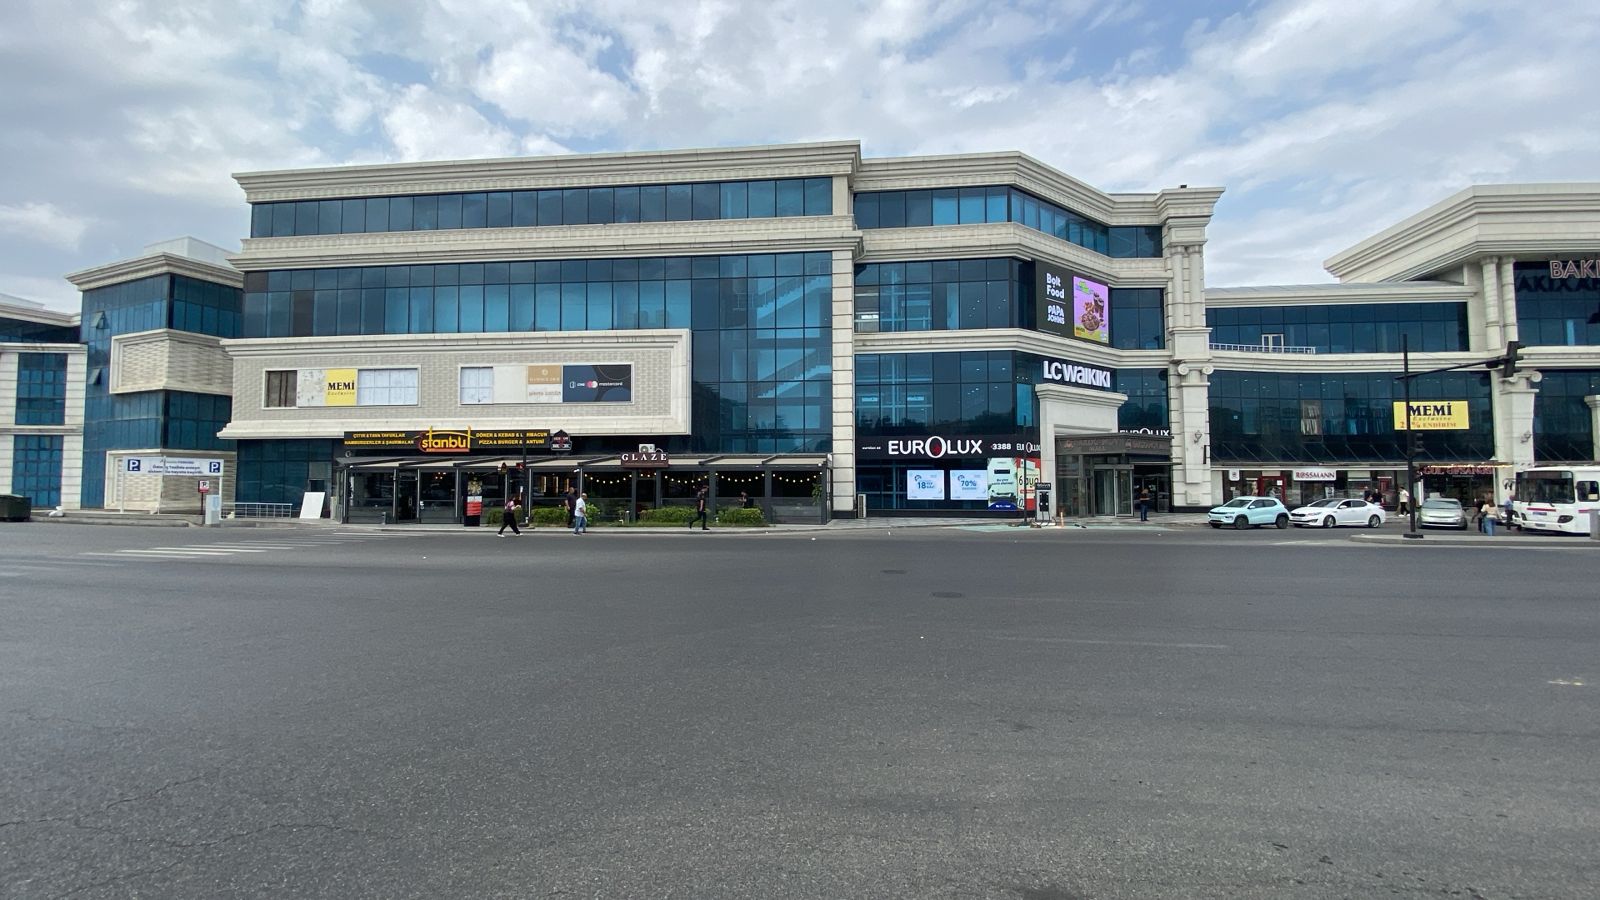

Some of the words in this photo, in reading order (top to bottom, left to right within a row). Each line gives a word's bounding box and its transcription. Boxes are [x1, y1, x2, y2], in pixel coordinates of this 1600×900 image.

[1046, 273, 1061, 287] Bolt
[1046, 285, 1065, 299] Food
[1047, 305, 1065, 317] PAPA
[1047, 314, 1065, 325] JOHNS
[327, 380, 355, 390] MEMİ
[1408, 402, 1452, 416] MEMİ
[888, 436, 983, 458] EUROLUX
[621, 453, 667, 461] GLAZE
[129, 460, 139, 471] P
[211, 462, 219, 471] P
[1295, 471, 1335, 479] ROSSMANN
[917, 481, 926, 489] 18
